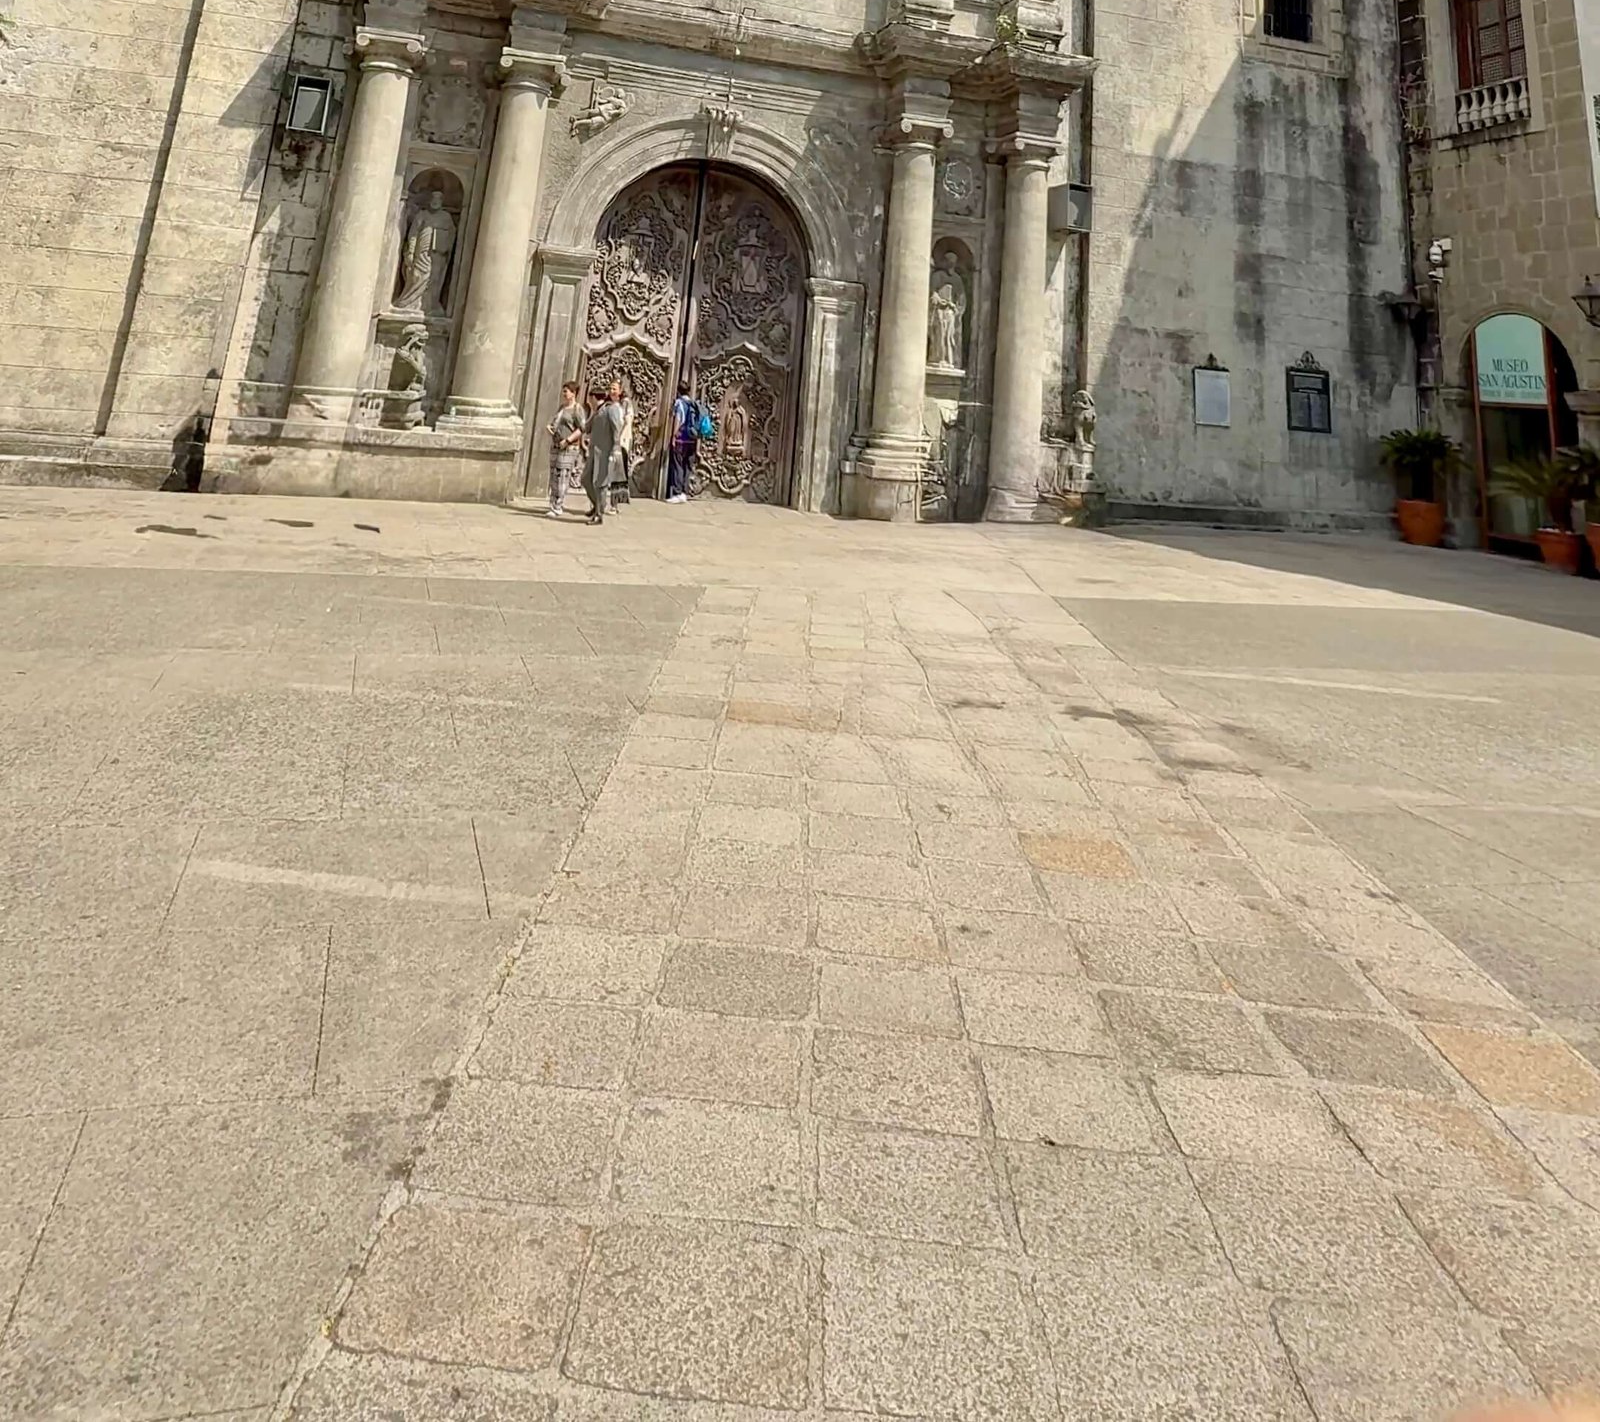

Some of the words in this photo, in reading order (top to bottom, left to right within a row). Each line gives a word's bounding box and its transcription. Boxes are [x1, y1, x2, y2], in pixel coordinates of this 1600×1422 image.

[1491, 358, 1529, 373] MUSEO
[1478, 373, 1499, 387] SAN
[1501, 374, 1546, 389] AGUSTIN
